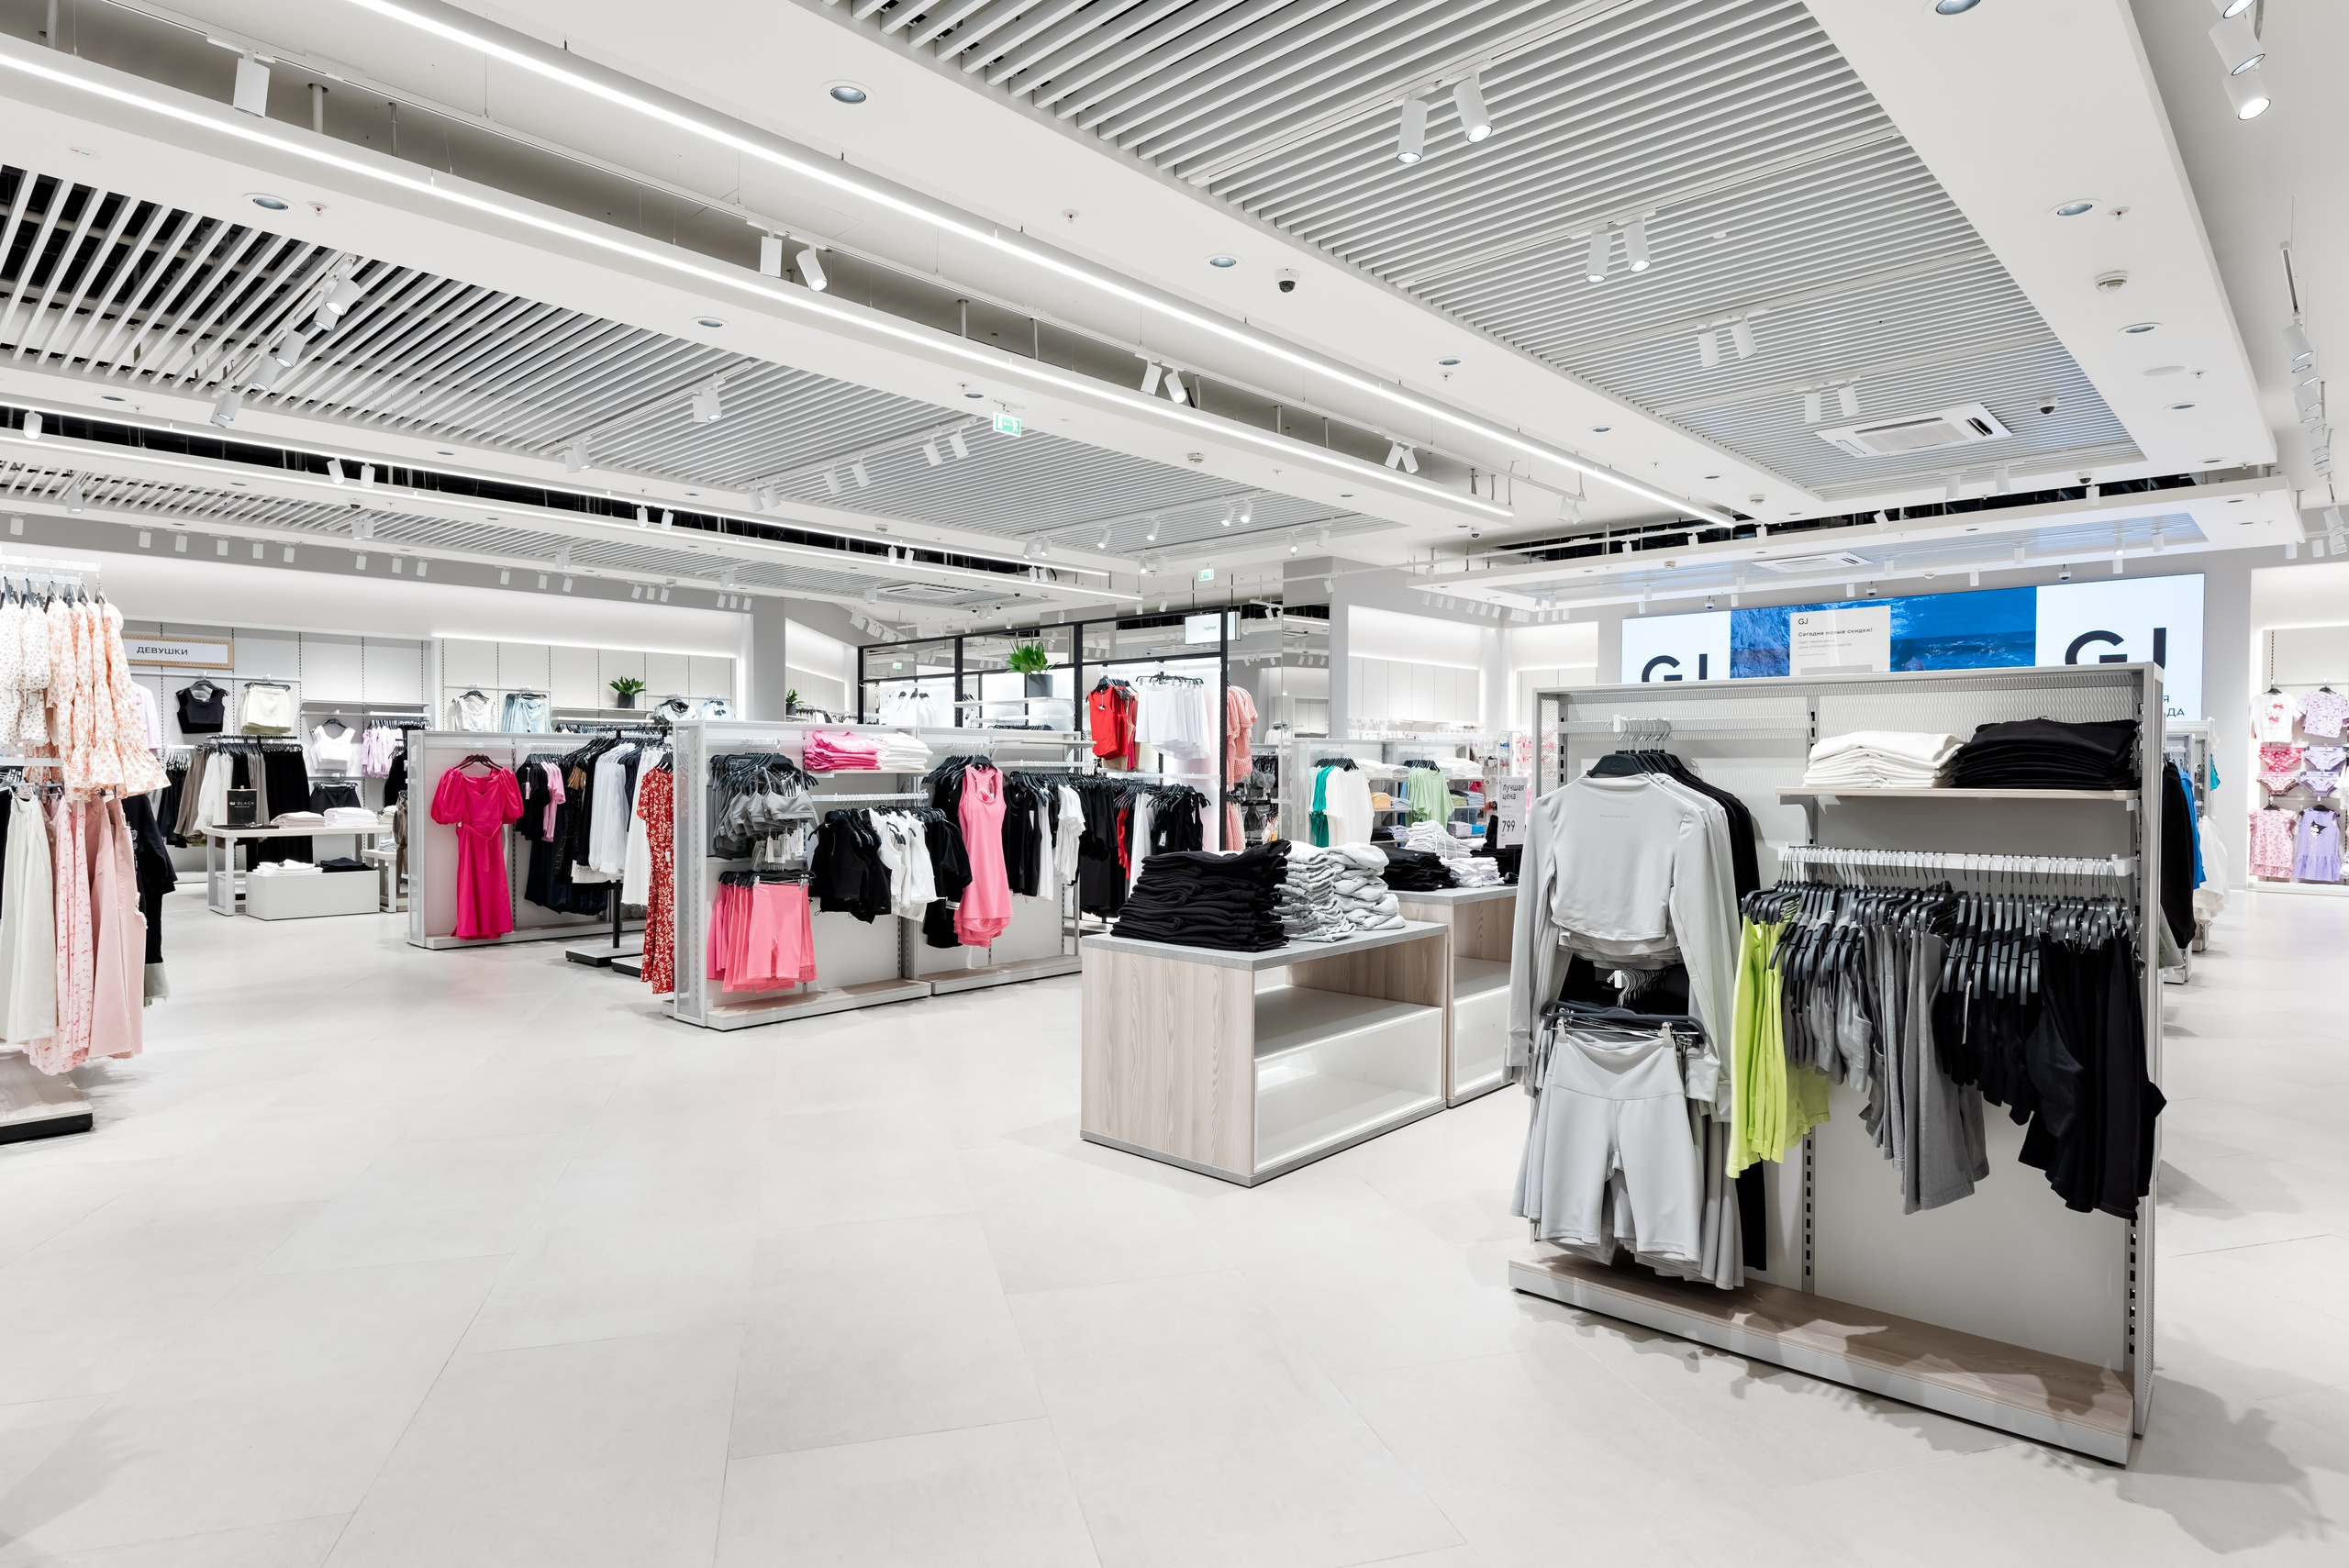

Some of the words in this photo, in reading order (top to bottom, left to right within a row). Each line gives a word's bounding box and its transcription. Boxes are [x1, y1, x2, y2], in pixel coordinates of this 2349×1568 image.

[137, 646, 188, 655] ДЕВУШКИ
[1502, 784, 1524, 793] лучшая
[1502, 820, 1516, 832] 799
